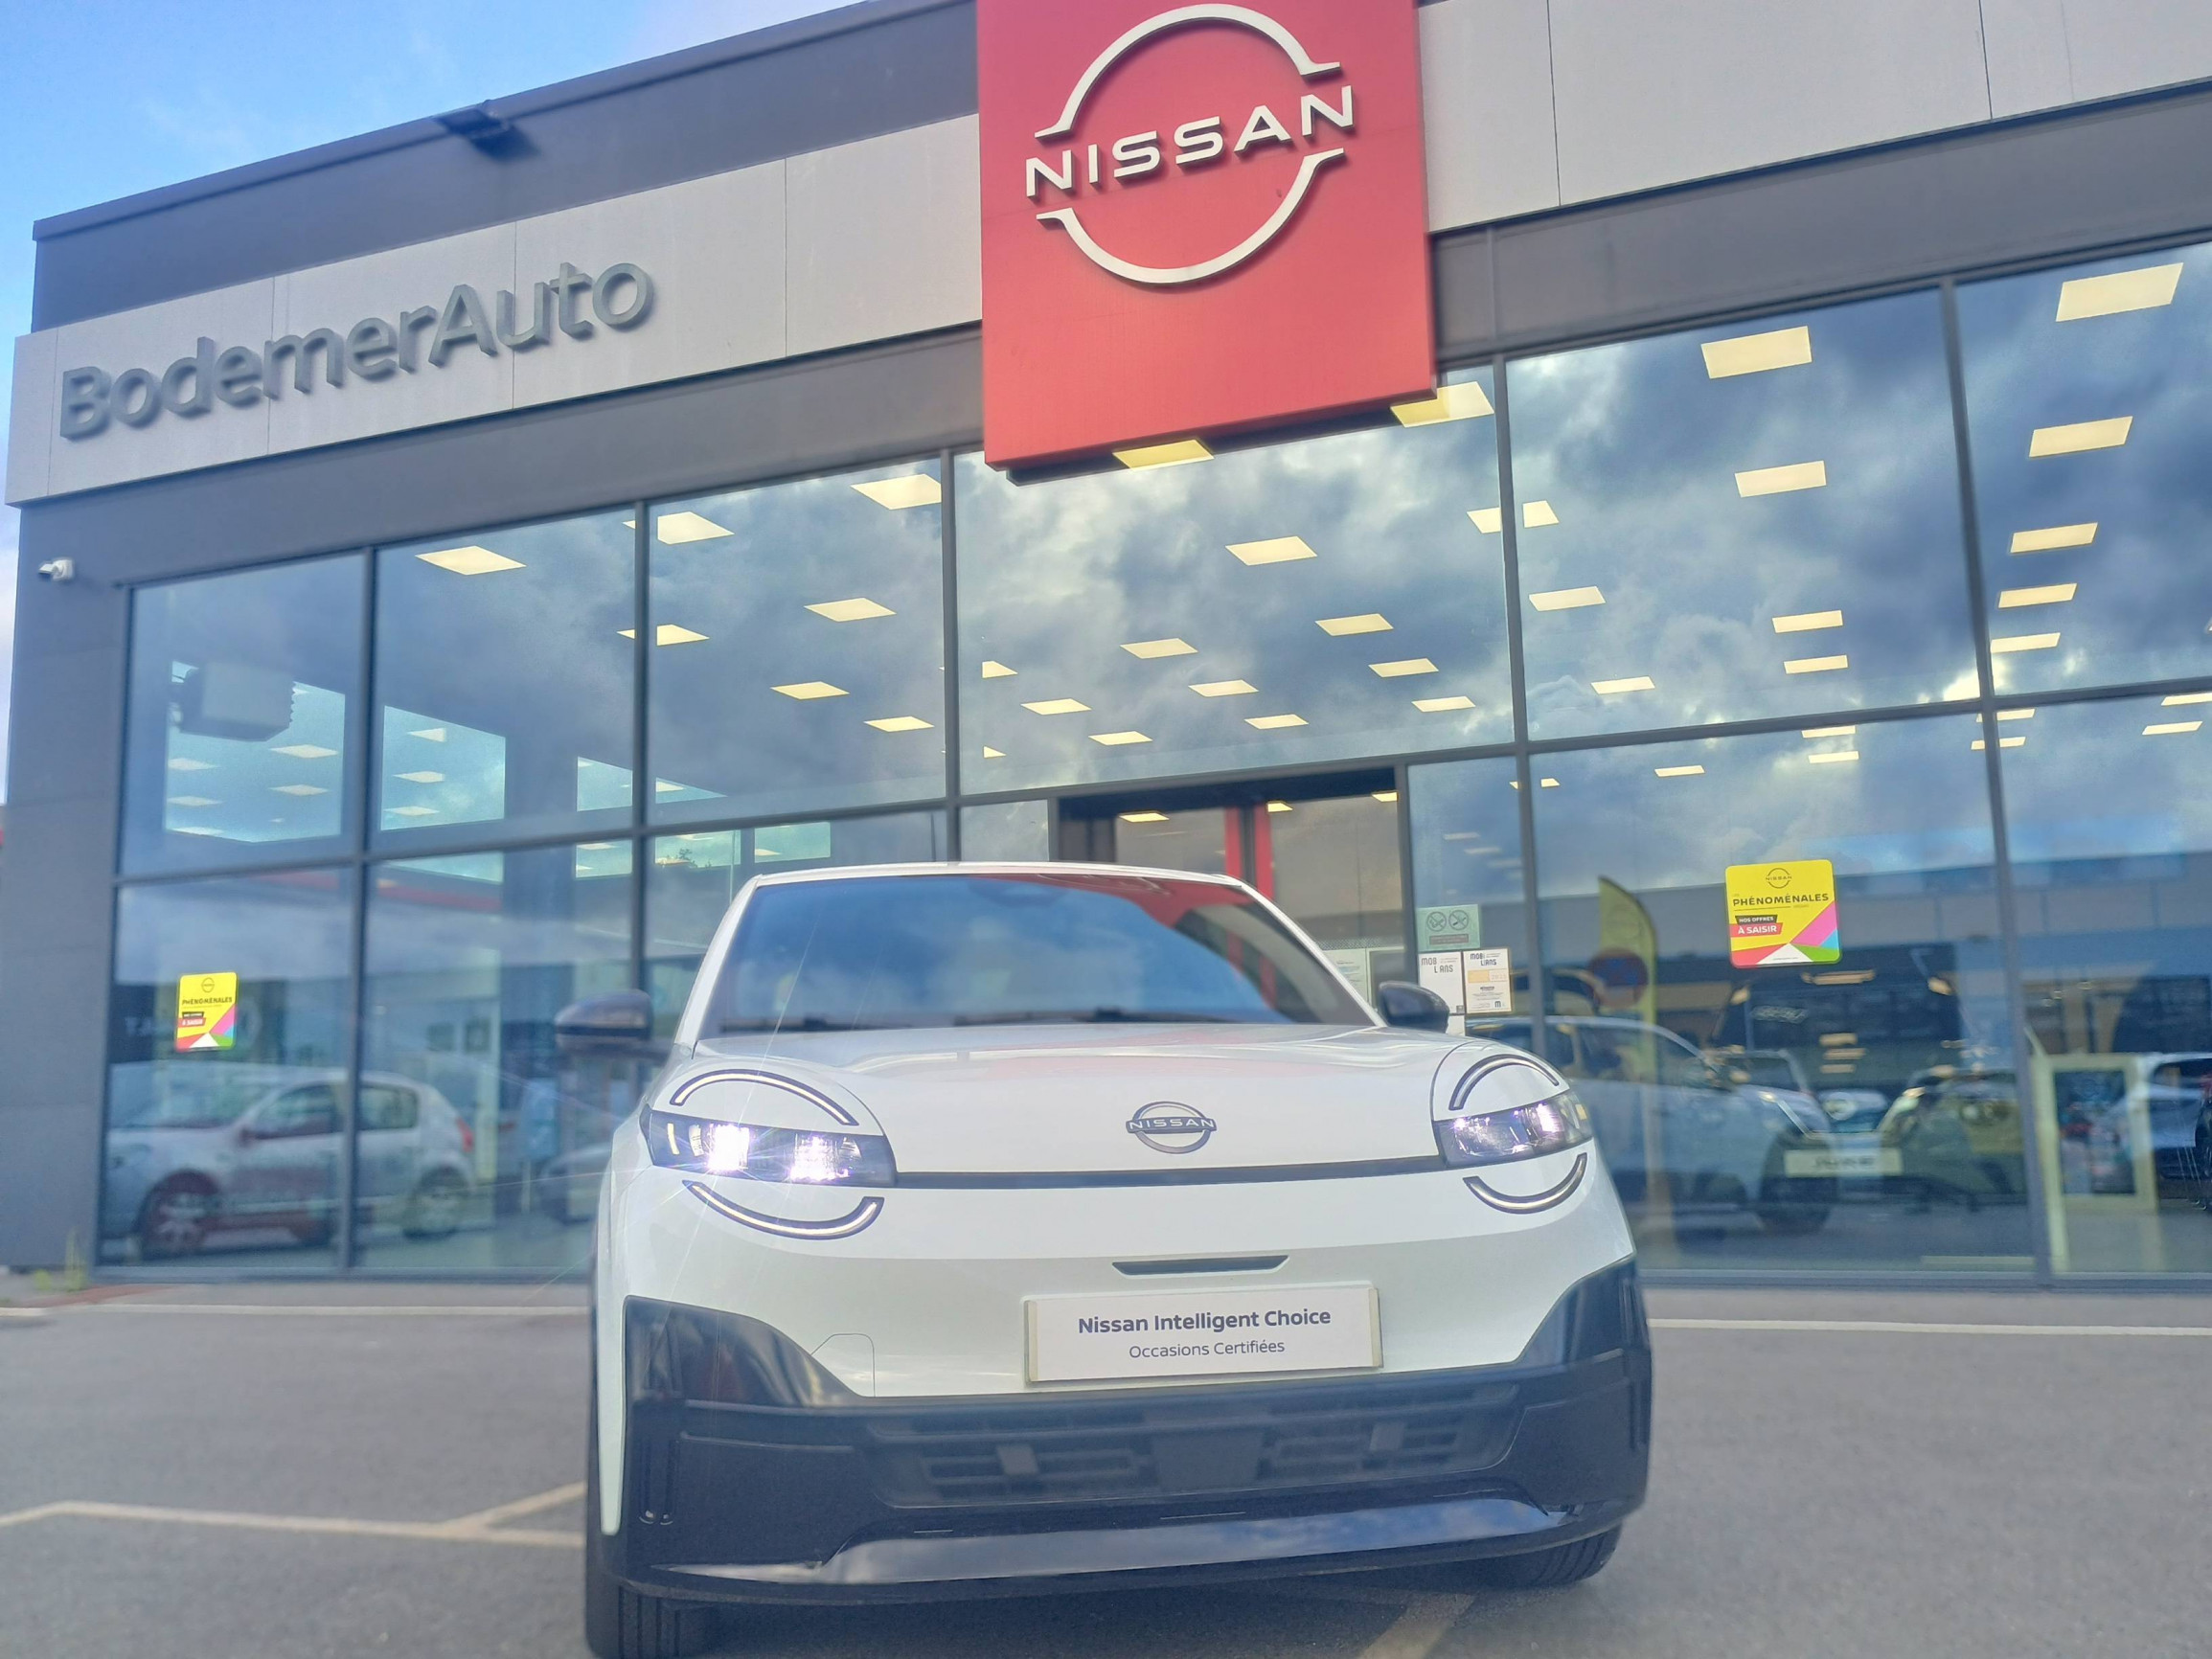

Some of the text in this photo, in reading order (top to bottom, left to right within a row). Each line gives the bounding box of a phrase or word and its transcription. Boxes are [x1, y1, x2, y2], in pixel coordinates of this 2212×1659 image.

[1025, 84, 1355, 199] NISSAN
[59, 261, 655, 441] BodemerAuto
[1732, 893, 1830, 907] PHÉNOMÉNALES
[1738, 925, 1777, 935] À SAISIR
[1129, 1119, 1215, 1129] NISSAN
[1078, 1308, 1332, 1335] Nissan Intelligent Choice
[1129, 1339, 1286, 1358] Occasions Certifiées
